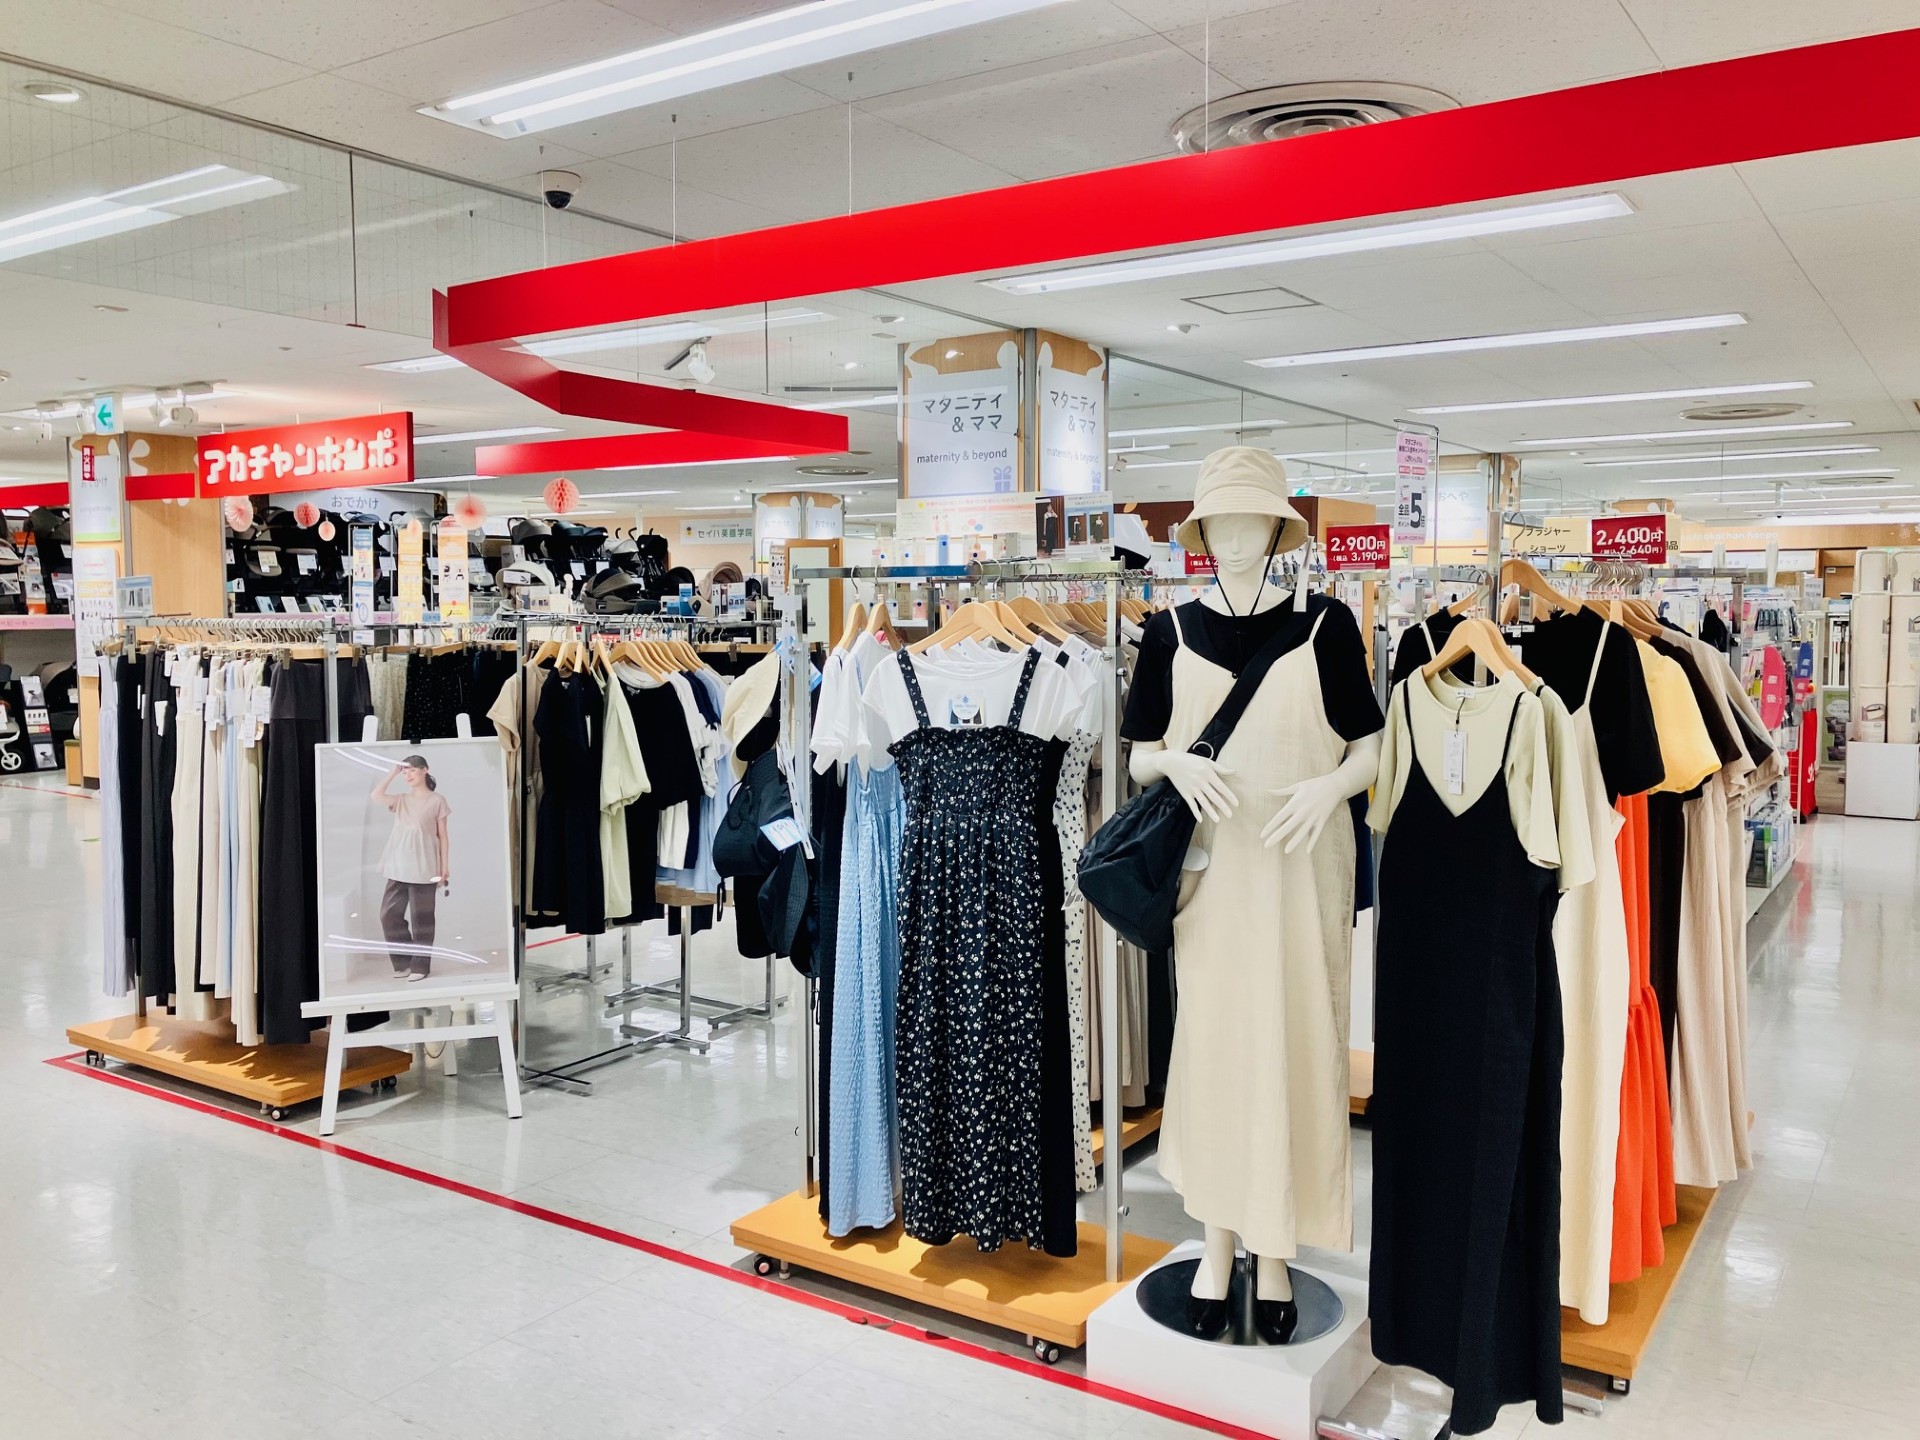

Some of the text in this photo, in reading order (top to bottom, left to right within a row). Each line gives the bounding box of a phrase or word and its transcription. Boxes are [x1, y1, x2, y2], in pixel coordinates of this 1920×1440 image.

[922, 393, 1002, 414] マタニティ
[1050, 390, 1096, 416] マタニティ
[952, 414, 1002, 433] & ママ
[1079, 418, 1096, 435] ママ
[204, 428, 396, 485] アカチャンホンポ
[917, 448, 1007, 464] maternity & beyond
[331, 496, 379, 510] おでかけ
[1410, 492, 1422, 528] 5
[1330, 536, 1385, 551] 2,900円
[1596, 527, 1662, 545] 2,400円
[1529, 545, 1566, 553] ショーツ
